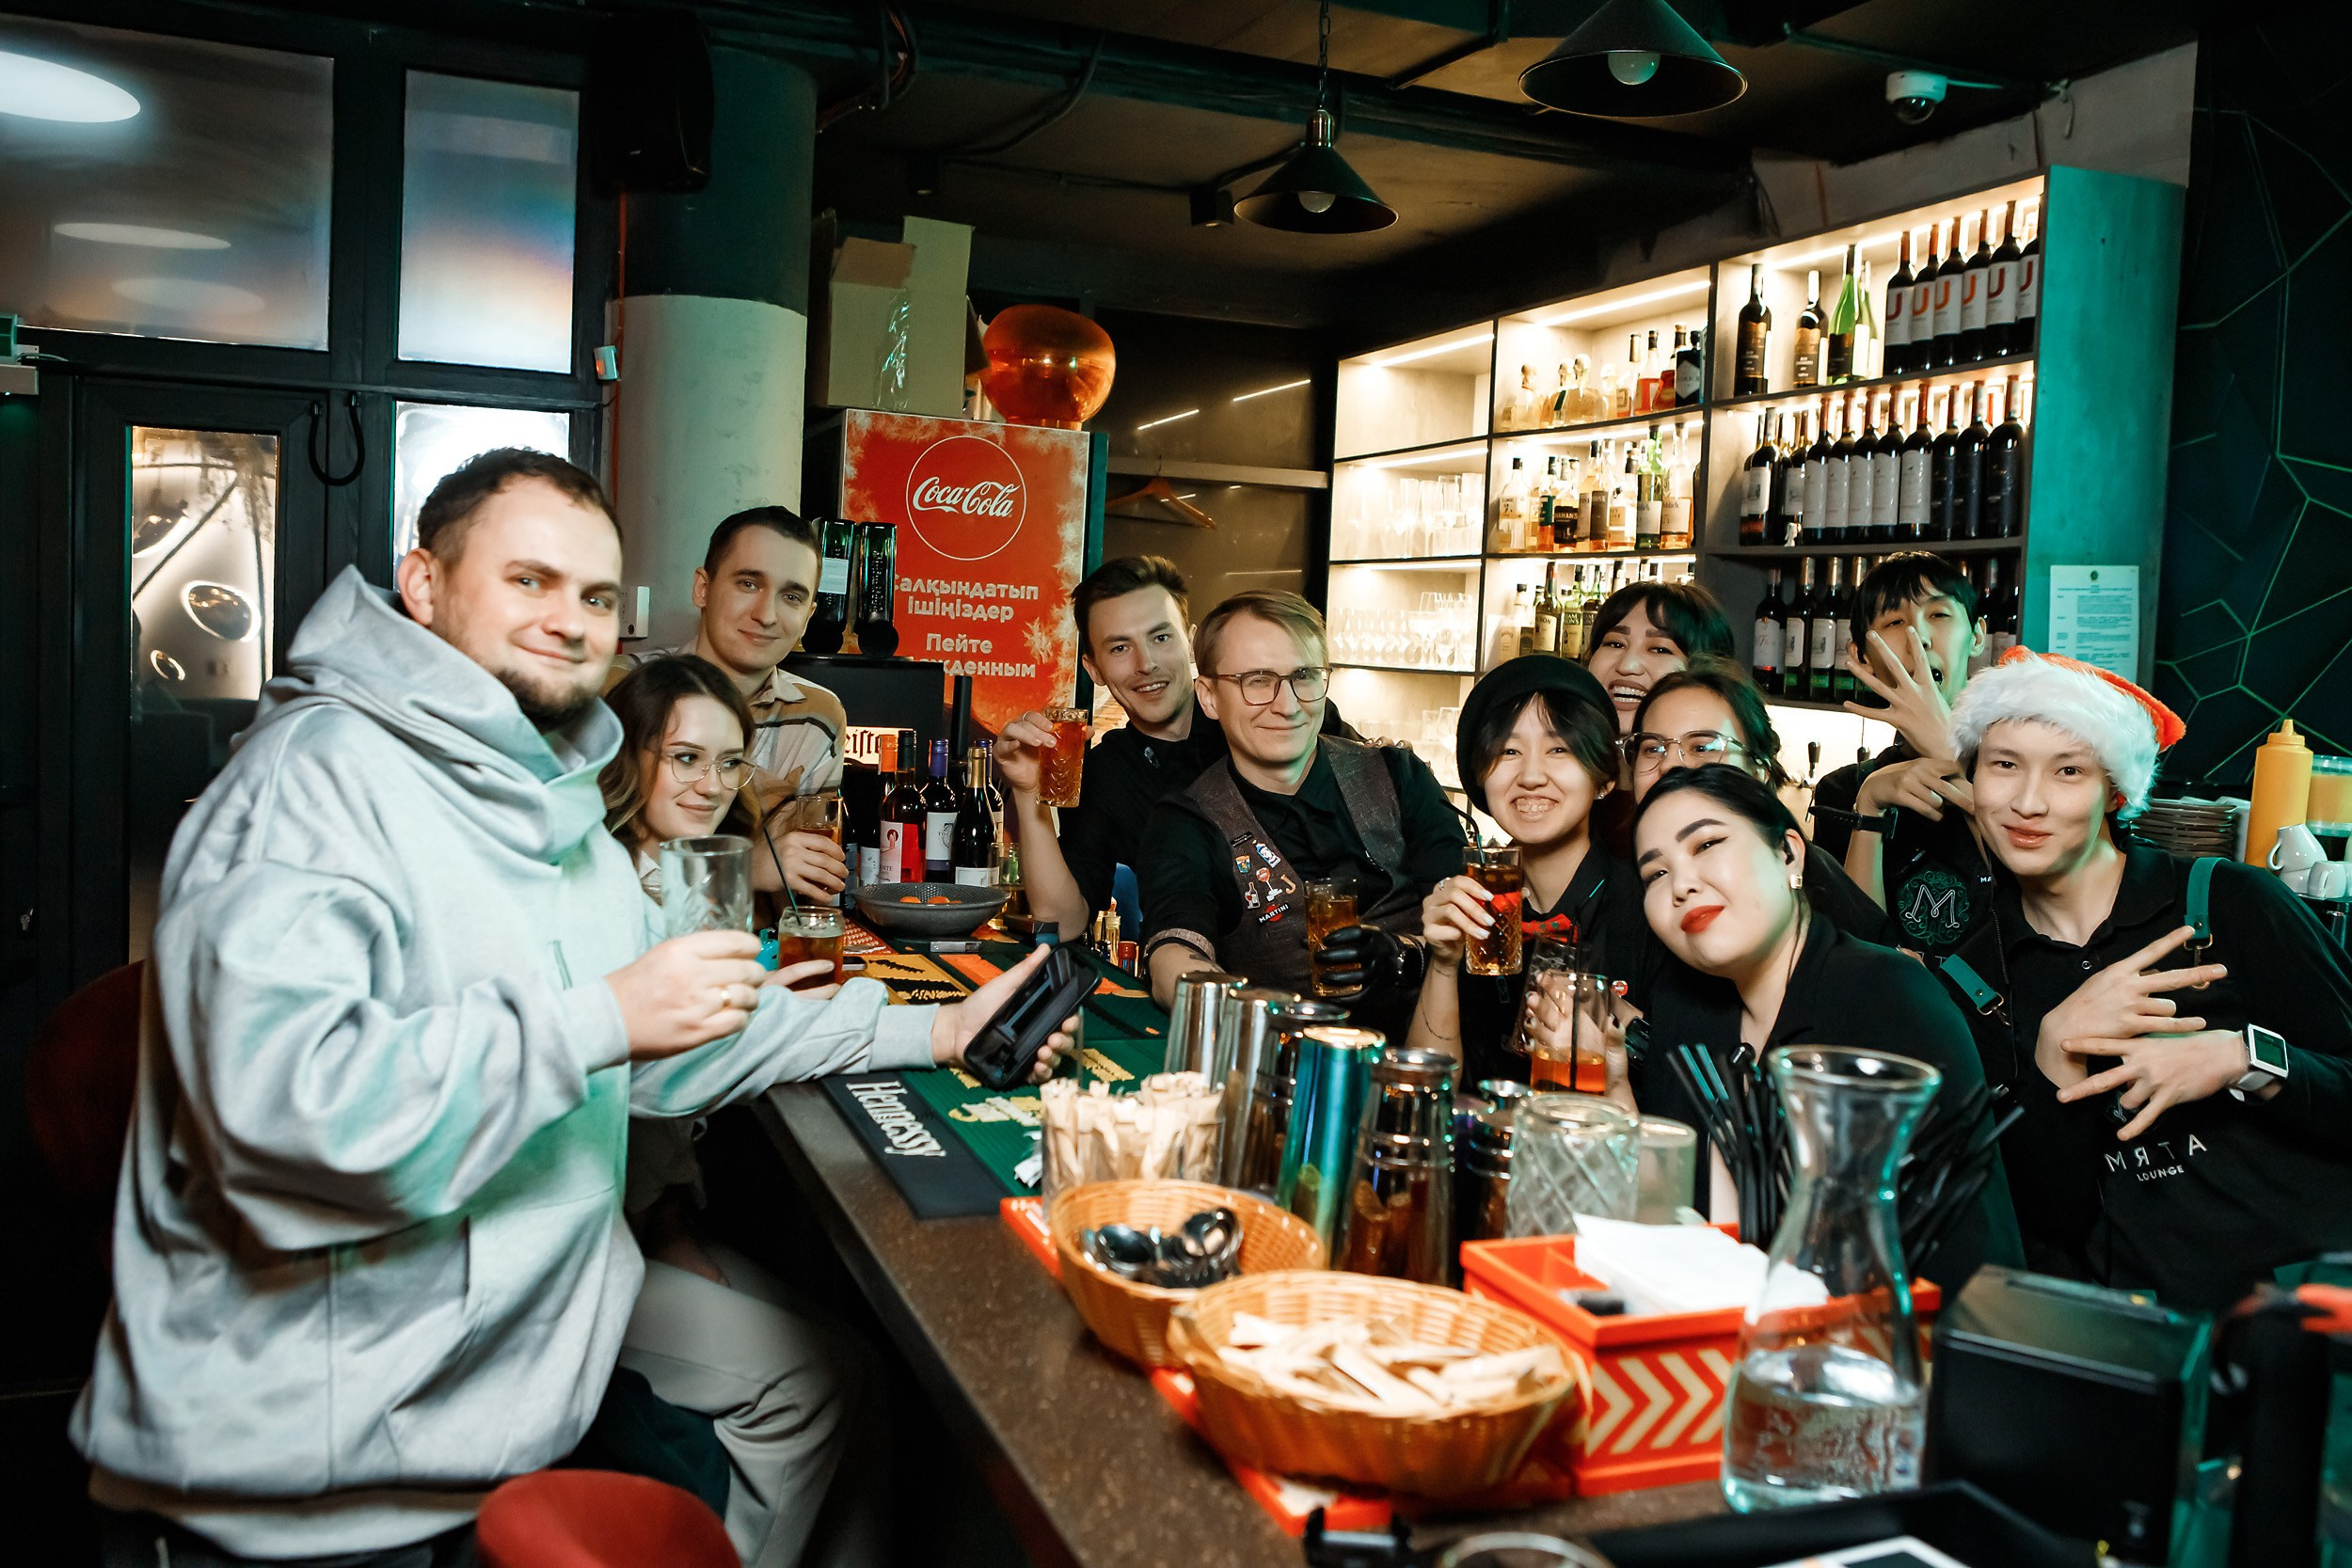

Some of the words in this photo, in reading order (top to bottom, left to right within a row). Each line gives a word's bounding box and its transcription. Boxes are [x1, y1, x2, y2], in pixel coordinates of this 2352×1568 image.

[913, 476, 1021, 518] Coca-Cola
[926, 633, 993, 655] Пейте
[1259, 904, 1289, 923] MARTINI
[847, 1081, 946, 1157] Hennessy
[2137, 1164, 2185, 1182] LOUNGE
